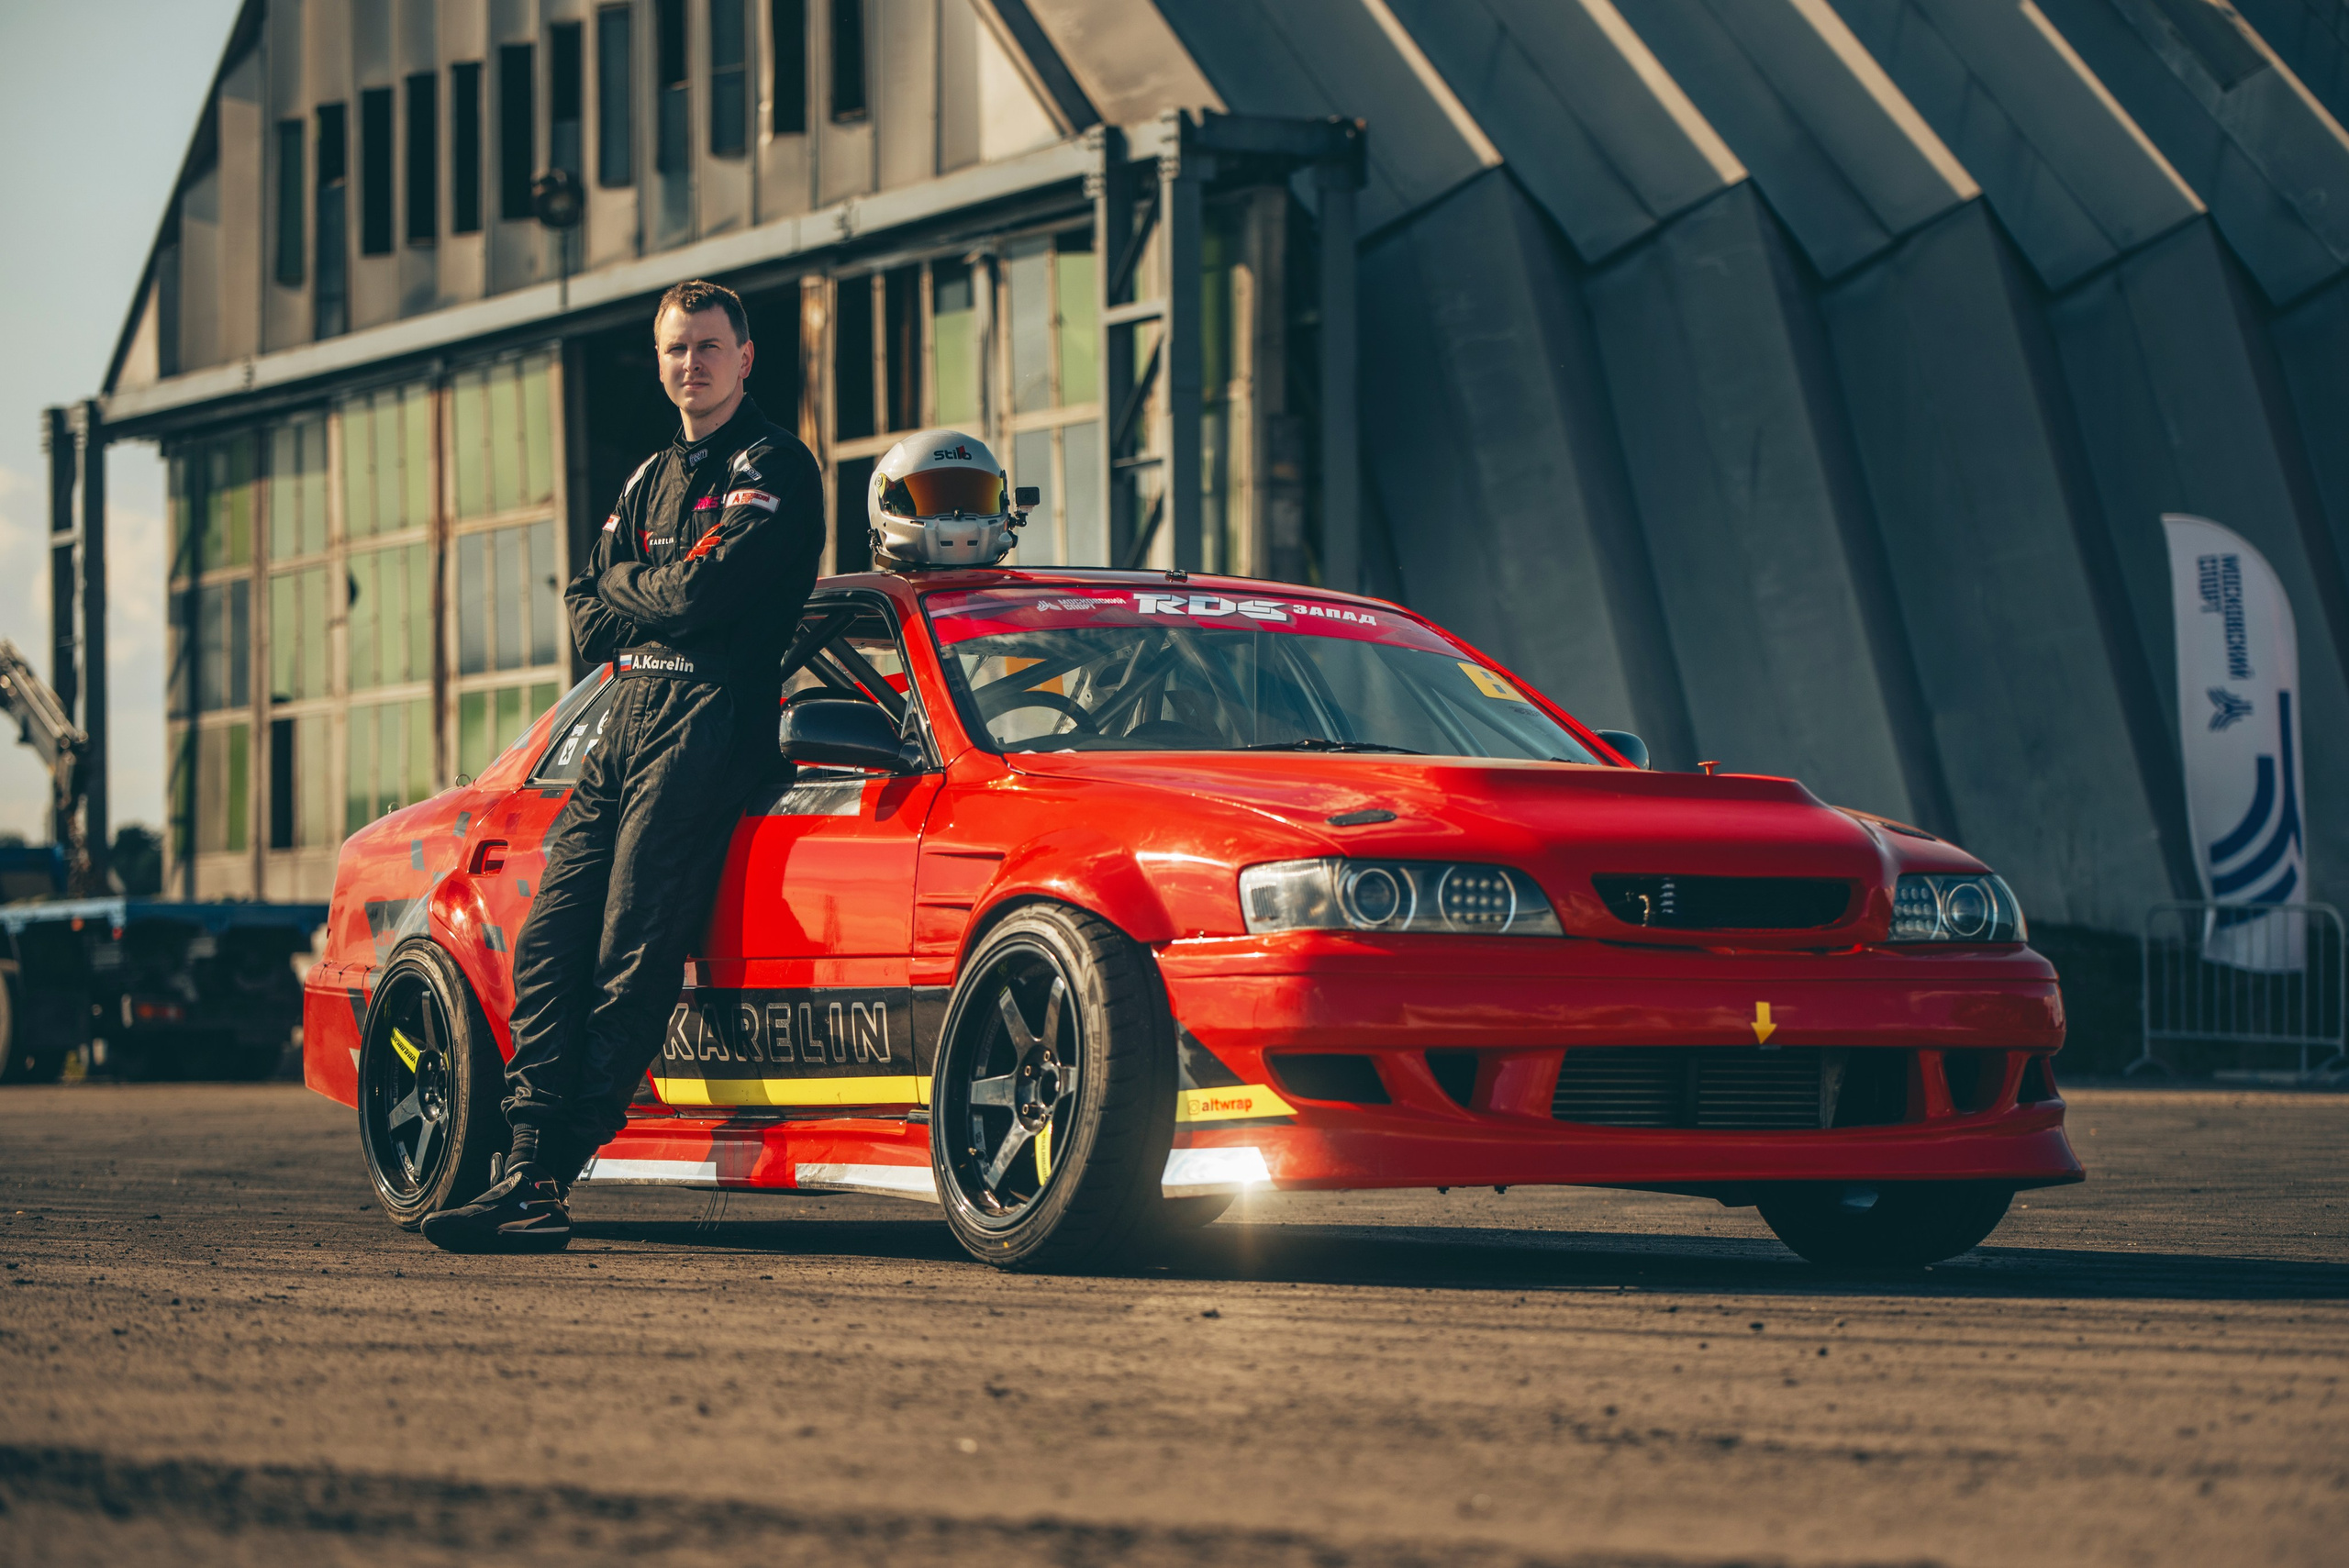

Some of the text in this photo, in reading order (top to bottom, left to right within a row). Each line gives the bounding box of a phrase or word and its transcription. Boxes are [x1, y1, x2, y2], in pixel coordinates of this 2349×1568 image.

[933, 445, 973, 461] Stilo
[1133, 593, 1286, 621] RDS
[1292, 604, 1376, 626] ЗАПАД
[632, 654, 694, 673] A.Karelin
[663, 1002, 891, 1063] KARELIN
[1201, 1098, 1252, 1112] altwrap
